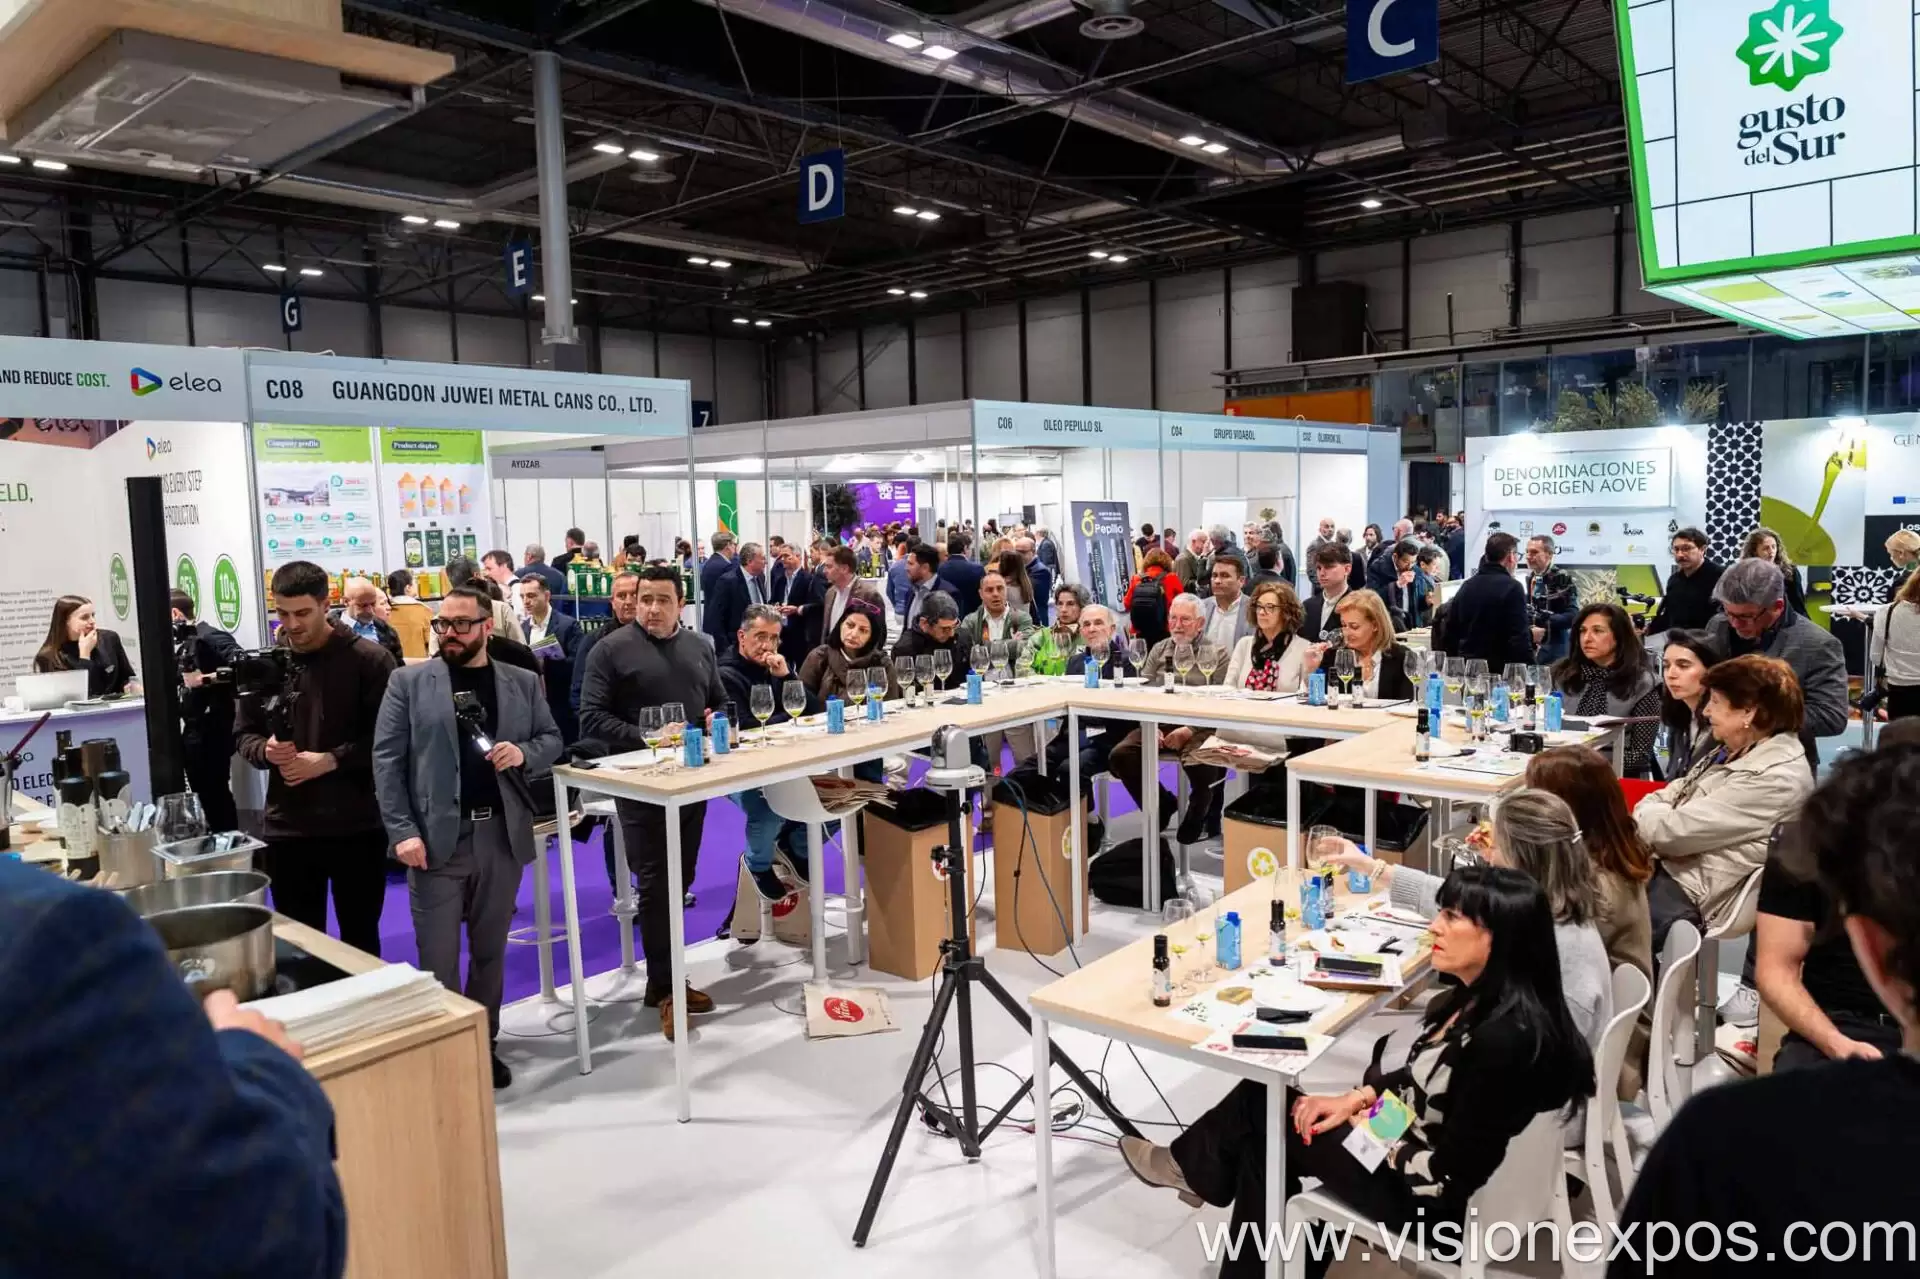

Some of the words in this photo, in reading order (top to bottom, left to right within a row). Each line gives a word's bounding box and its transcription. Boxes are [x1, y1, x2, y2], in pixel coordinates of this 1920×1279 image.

[1367, 0, 1416, 57] C
[1737, 92, 1846, 150] gusto
[1744, 147, 1770, 166] del
[1772, 130, 1846, 165] Sur
[808, 163, 834, 211] D
[512, 249, 526, 287] E
[284, 297, 298, 326] G
[0, 370, 20, 385] ND
[24, 370, 73, 386] REDUCE
[76, 372, 110, 388] COST.
[169, 371, 222, 393] elea
[266, 379, 304, 399] C08
[332, 380, 435, 403] GUANGDON
[441, 384, 493, 405] JUWEI
[499, 387, 549, 408] METAL
[555, 391, 593, 411] CANS
[598, 394, 625, 415] CO.,
[629, 396, 657, 414] LTD.
[997, 416, 1013, 430] C06
[1043, 419, 1063, 432] OLEO
[1063, 419, 1093, 433] PEPILLO
[1094, 420, 1103, 433] SL
[1171, 425, 1183, 437] C04
[157, 438, 172, 454] elea
[188, 469, 202, 493] STEP
[1494, 460, 1656, 482] DENOMINACIONES
[1502, 482, 1523, 497] DE
[1528, 480, 1594, 496] ORIGEN
[1600, 477, 1647, 493] AOVE
[1094, 523, 1124, 536] Pepillo
